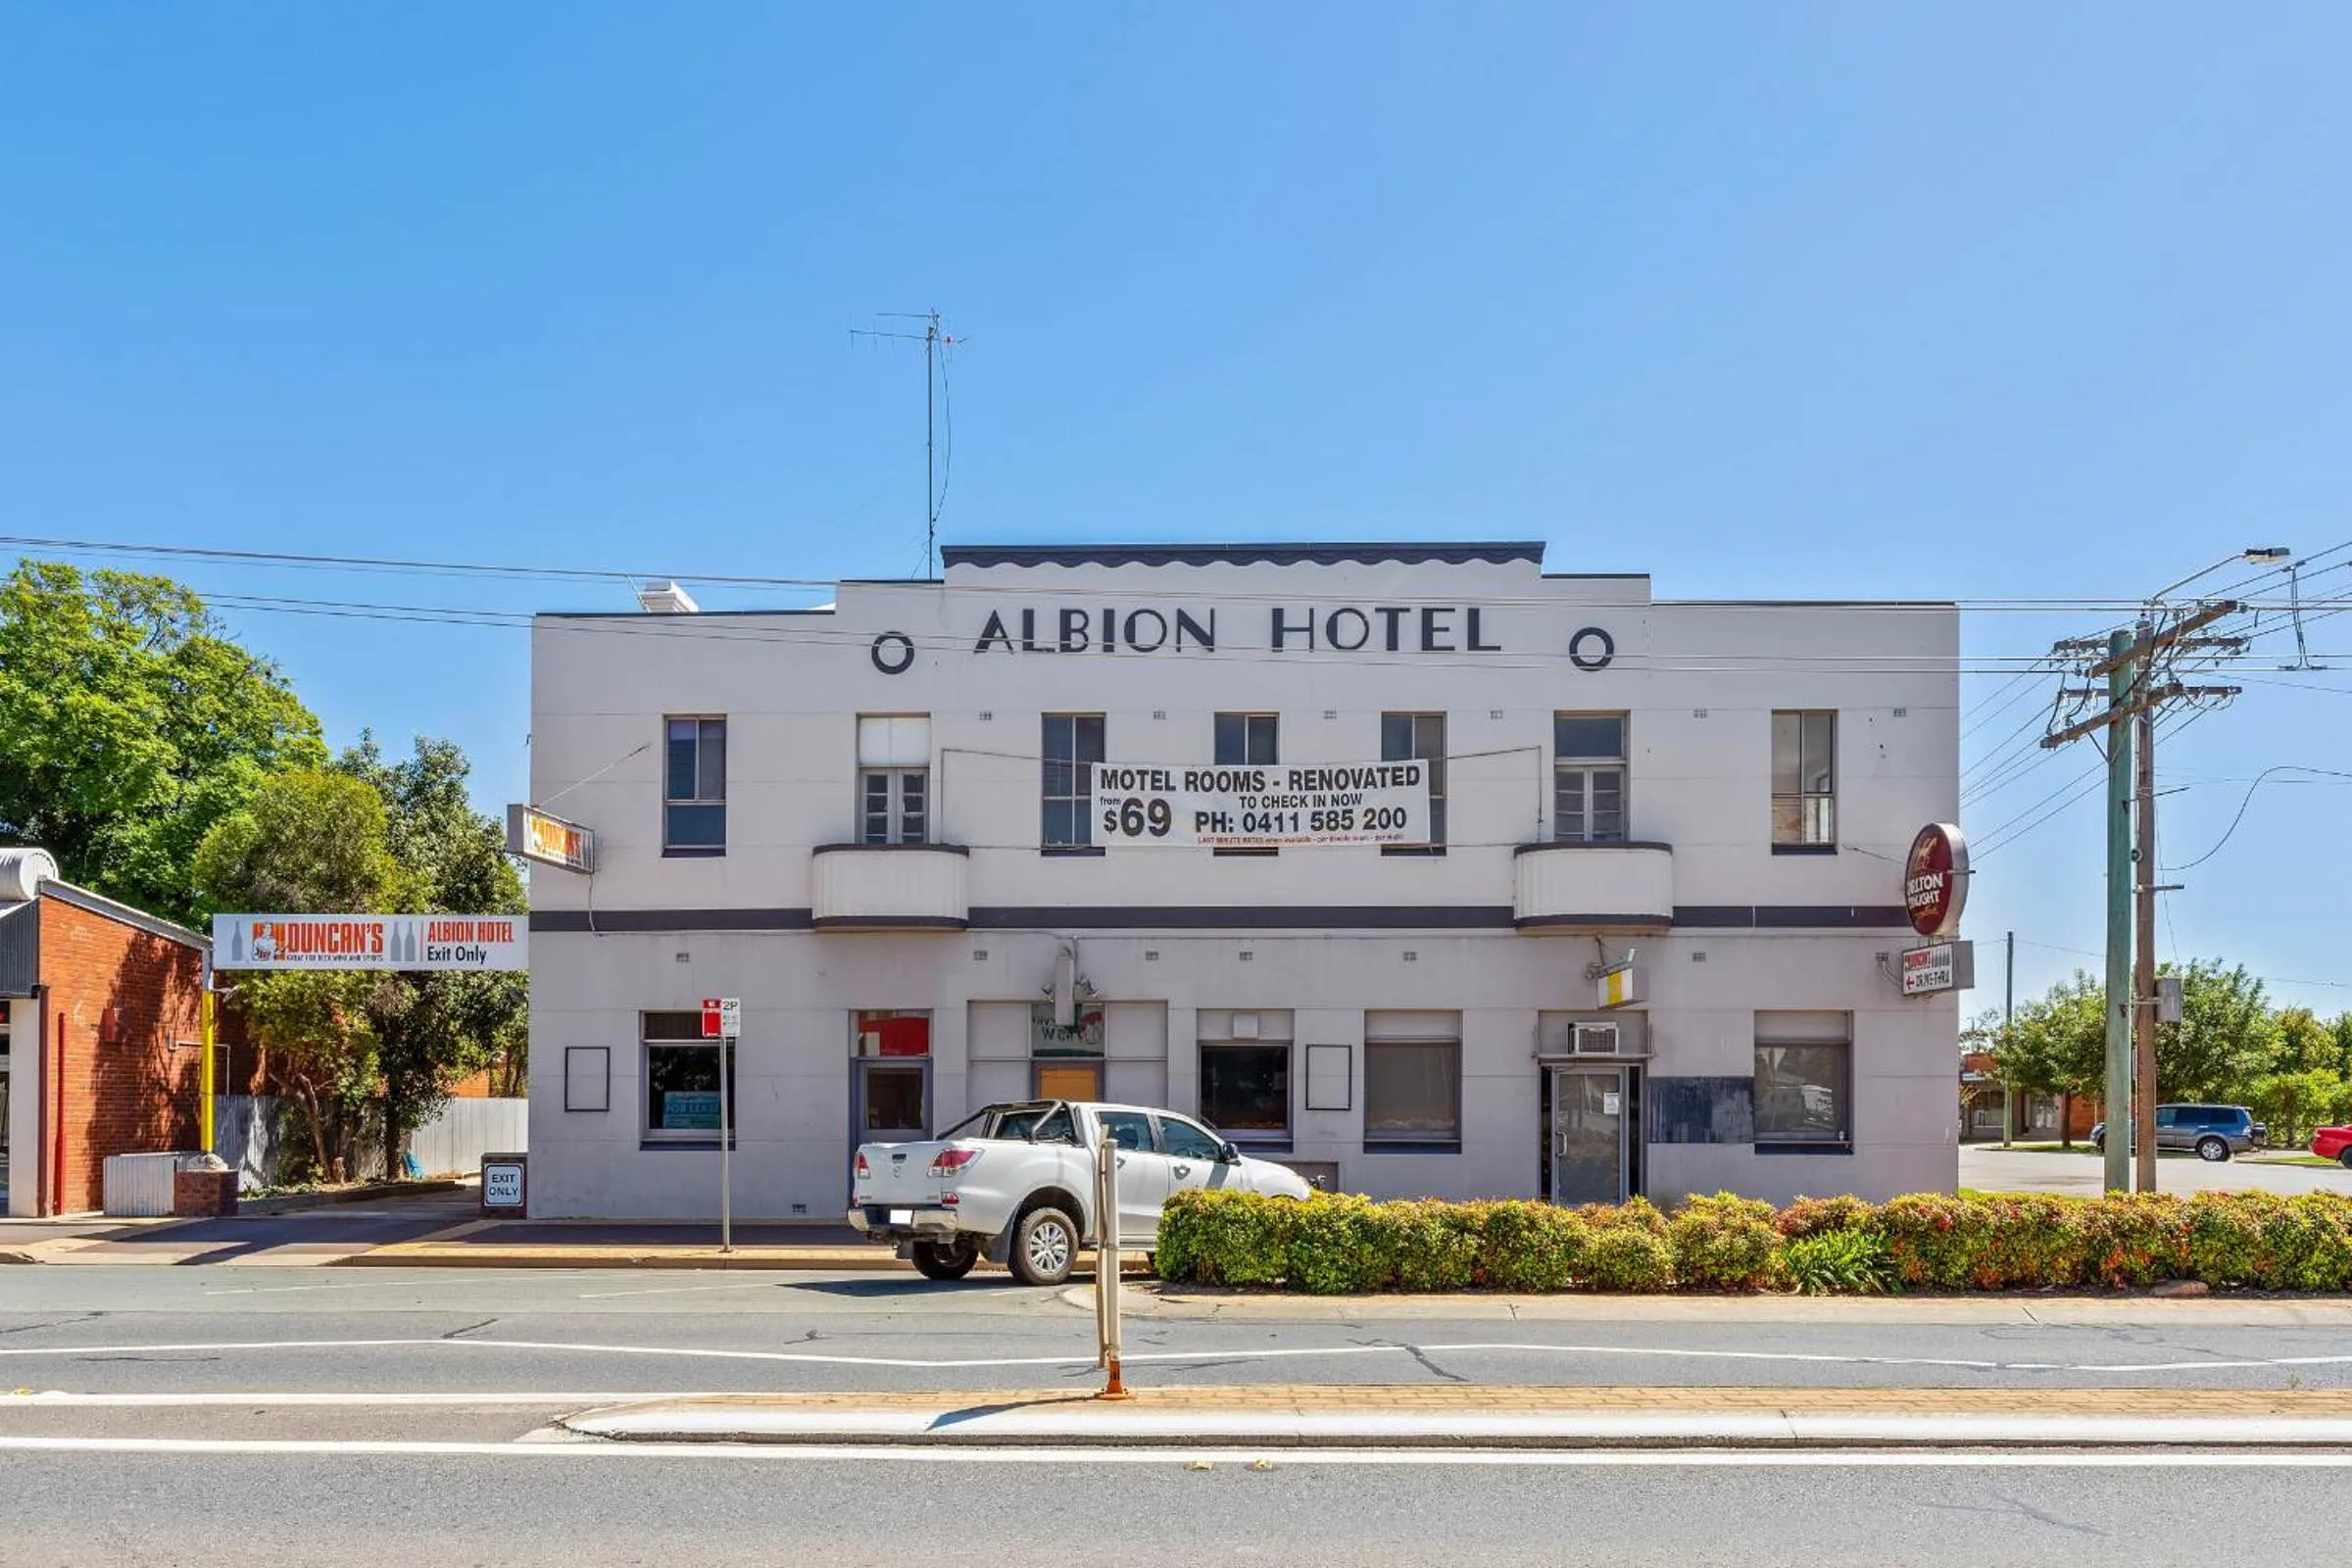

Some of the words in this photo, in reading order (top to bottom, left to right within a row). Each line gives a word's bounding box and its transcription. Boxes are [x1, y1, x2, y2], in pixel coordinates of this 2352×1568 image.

[973, 609, 1215, 655] ALBION
[1271, 608, 1501, 653] HOTEL
[1101, 768, 1176, 791] MOTEL
[1184, 770, 1266, 793] ROOMS
[1289, 765, 1420, 791] RENOVATED
[1100, 797, 1121, 806] from
[1239, 796, 1257, 809] TO
[1261, 794, 1308, 808] CHECK
[1313, 794, 1326, 808] IN
[1331, 793, 1363, 807] NOW
[1103, 797, 1172, 837] $69
[1195, 810, 1234, 833] PH:
[1242, 810, 1299, 833] 0411
[1310, 808, 1354, 832] 585
[1362, 807, 1407, 830] 200
[288, 922, 383, 954] DUNCAN'S
[427, 921, 474, 942] ALBION
[477, 921, 514, 943] HOTEL
[427, 946, 451, 961] Exit
[456, 945, 487, 964] Only
[722, 1001, 738, 1010] 2P
[492, 1174, 514, 1183] EXIT
[489, 1187, 518, 1196] ONLY
